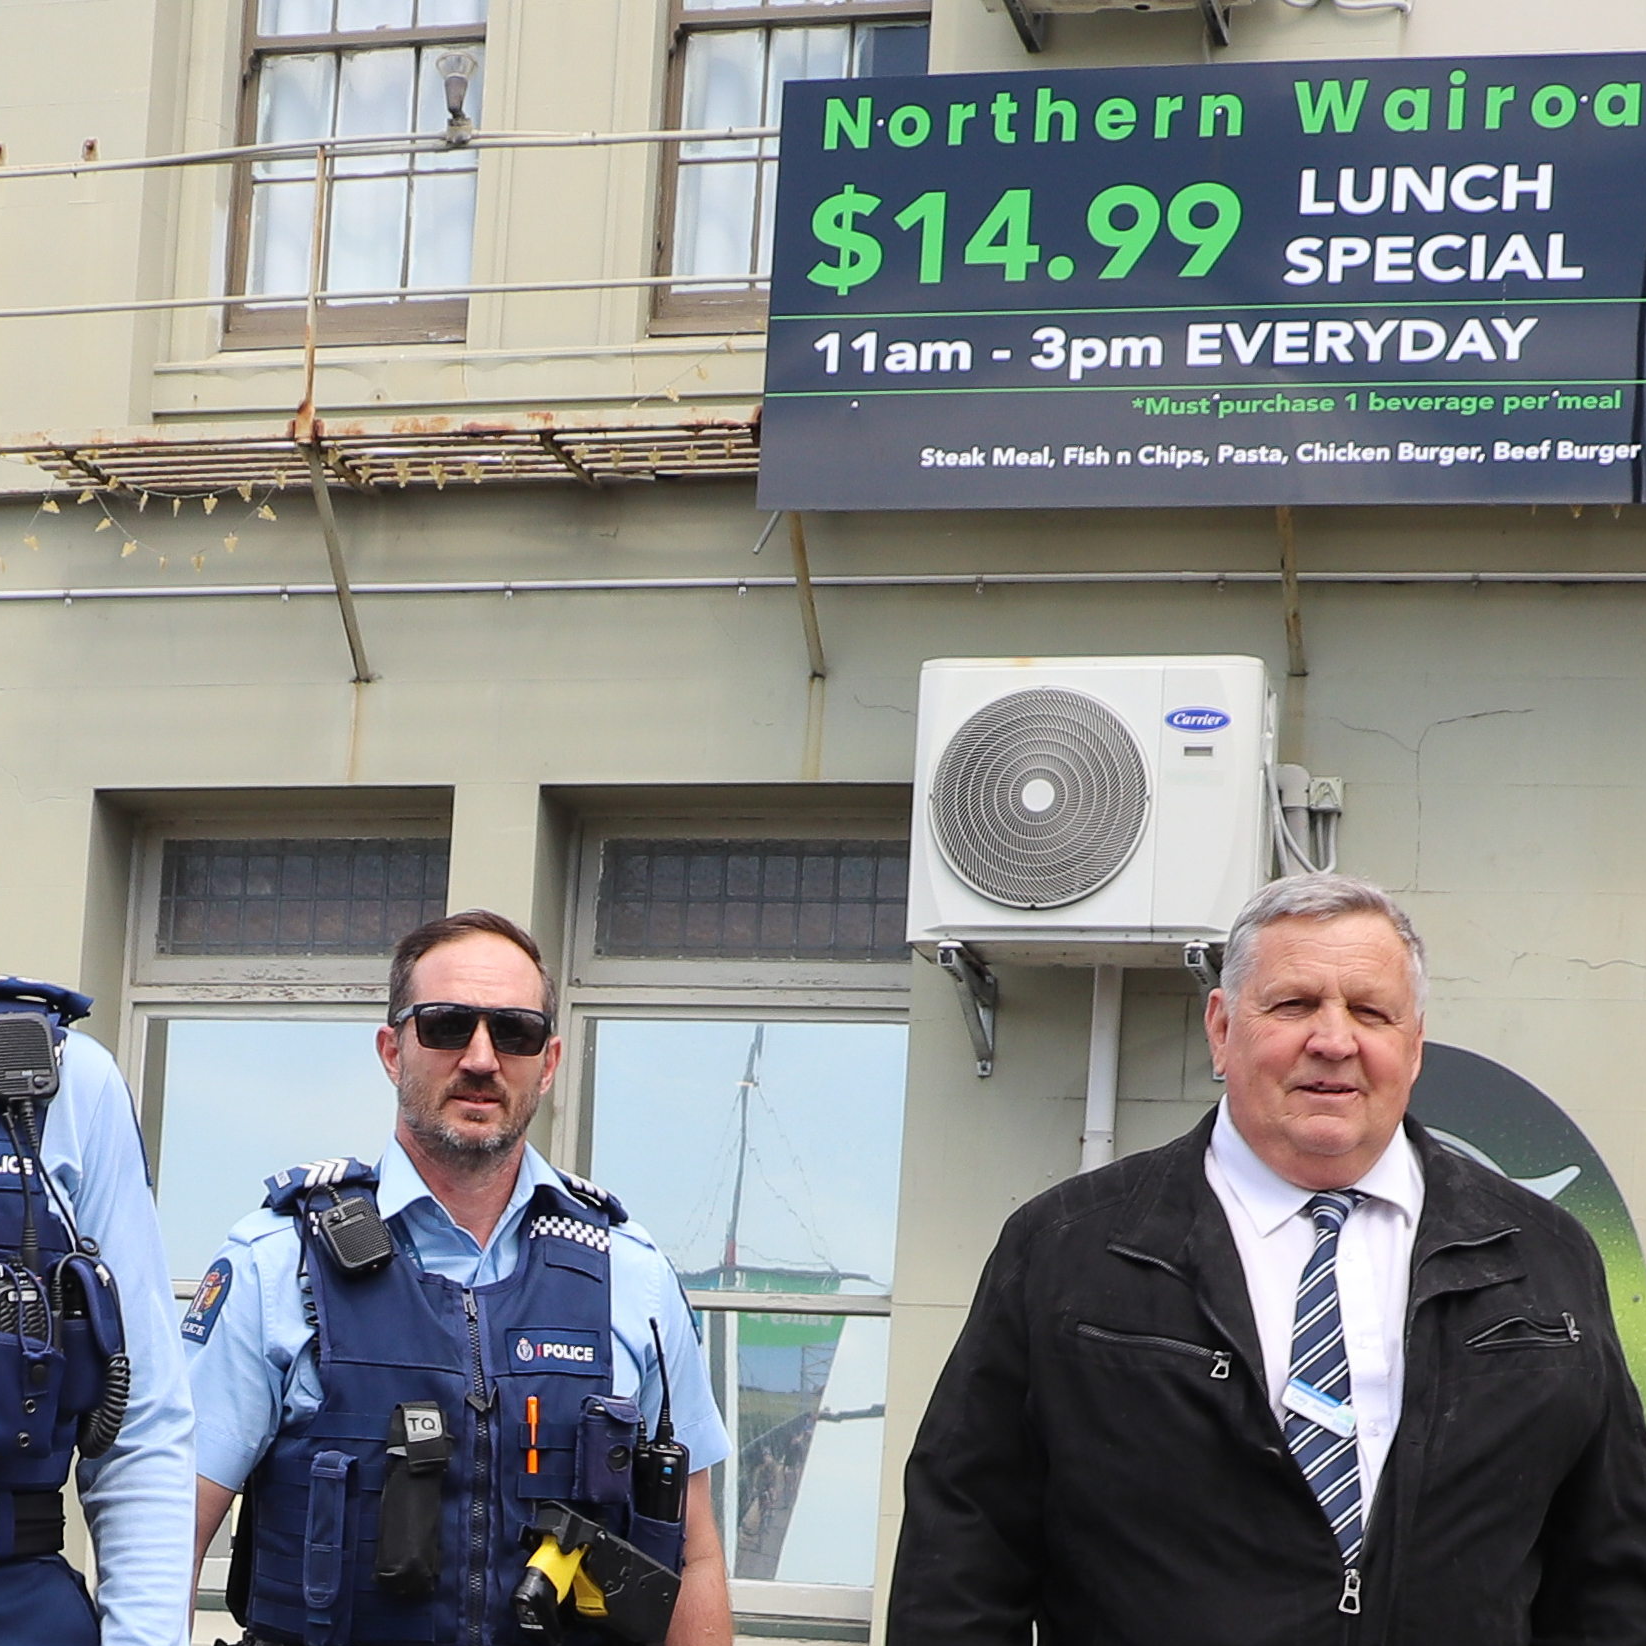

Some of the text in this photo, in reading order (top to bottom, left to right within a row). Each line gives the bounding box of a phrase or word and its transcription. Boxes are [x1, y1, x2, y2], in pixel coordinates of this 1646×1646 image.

[824, 69, 1643, 150] Northern Wairoa
[1298, 163, 1554, 215] LUNCH
[806, 183, 1242, 296] $14.99
[1282, 232, 1585, 287] SPECIAL
[813, 317, 1540, 382] 11am - 3pm EVERYDAY
[1219, 393, 1336, 419] purchase
[1347, 393, 1358, 412] 1
[1368, 391, 1495, 415] beverage
[1503, 395, 1551, 415] per
[1557, 389, 1622, 411] meal
[919, 439, 1642, 469] Steak Meal, Fish n Chips, Pasta, Chicken Burger, Beef Burger
[1172, 712, 1224, 726] Carrier
[542, 1343, 594, 1362] POLICE
[407, 1417, 437, 1432] TQ
